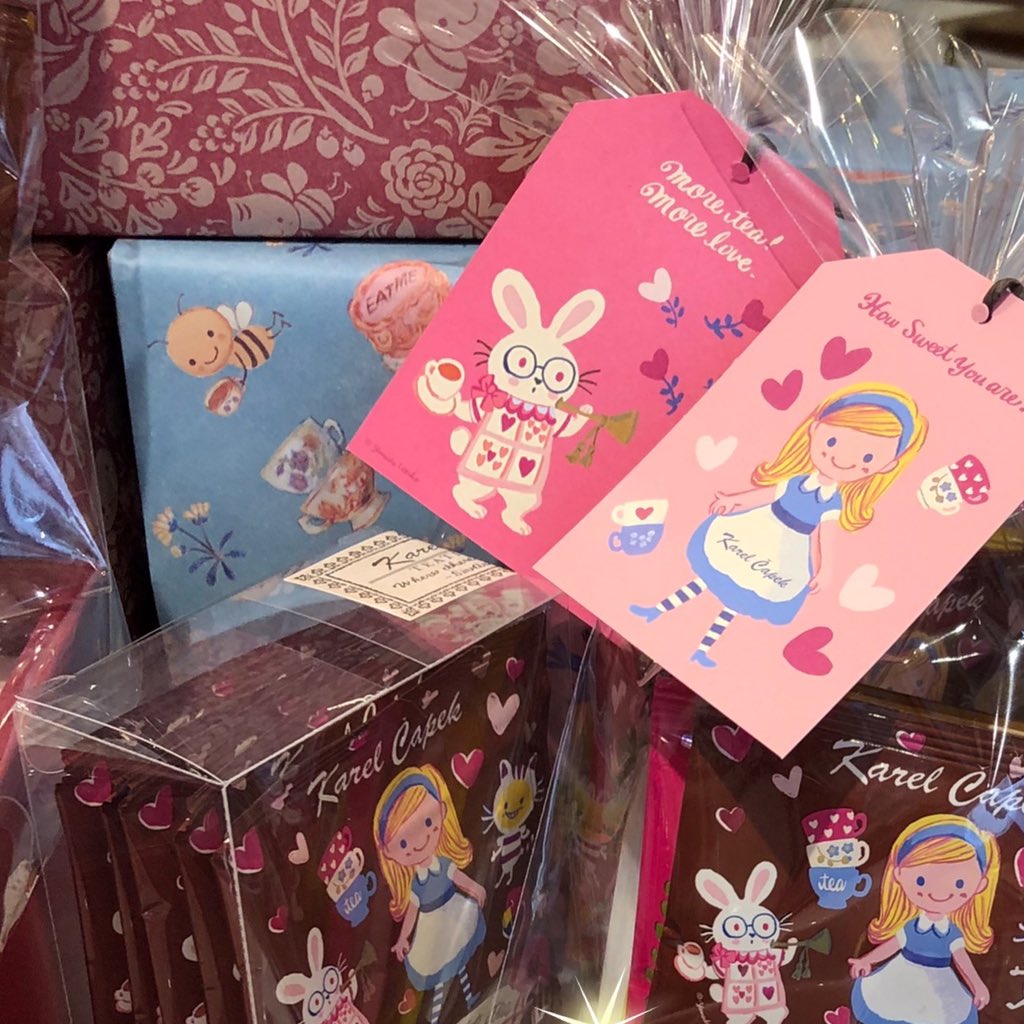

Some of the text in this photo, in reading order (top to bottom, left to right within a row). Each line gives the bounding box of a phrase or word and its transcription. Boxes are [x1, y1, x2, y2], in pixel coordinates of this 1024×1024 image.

[639, 182, 756, 280] More love.
[723, 209, 785, 252] tea!
[857, 292, 901, 329] How
[901, 318, 959, 362] Sweet
[371, 543, 438, 571] Kare
[716, 531, 757, 563] Karel
[921, 586, 984, 621] apek
[306, 740, 385, 818] Karel
[829, 738, 945, 794] Karel
[817, 872, 848, 893] tea
